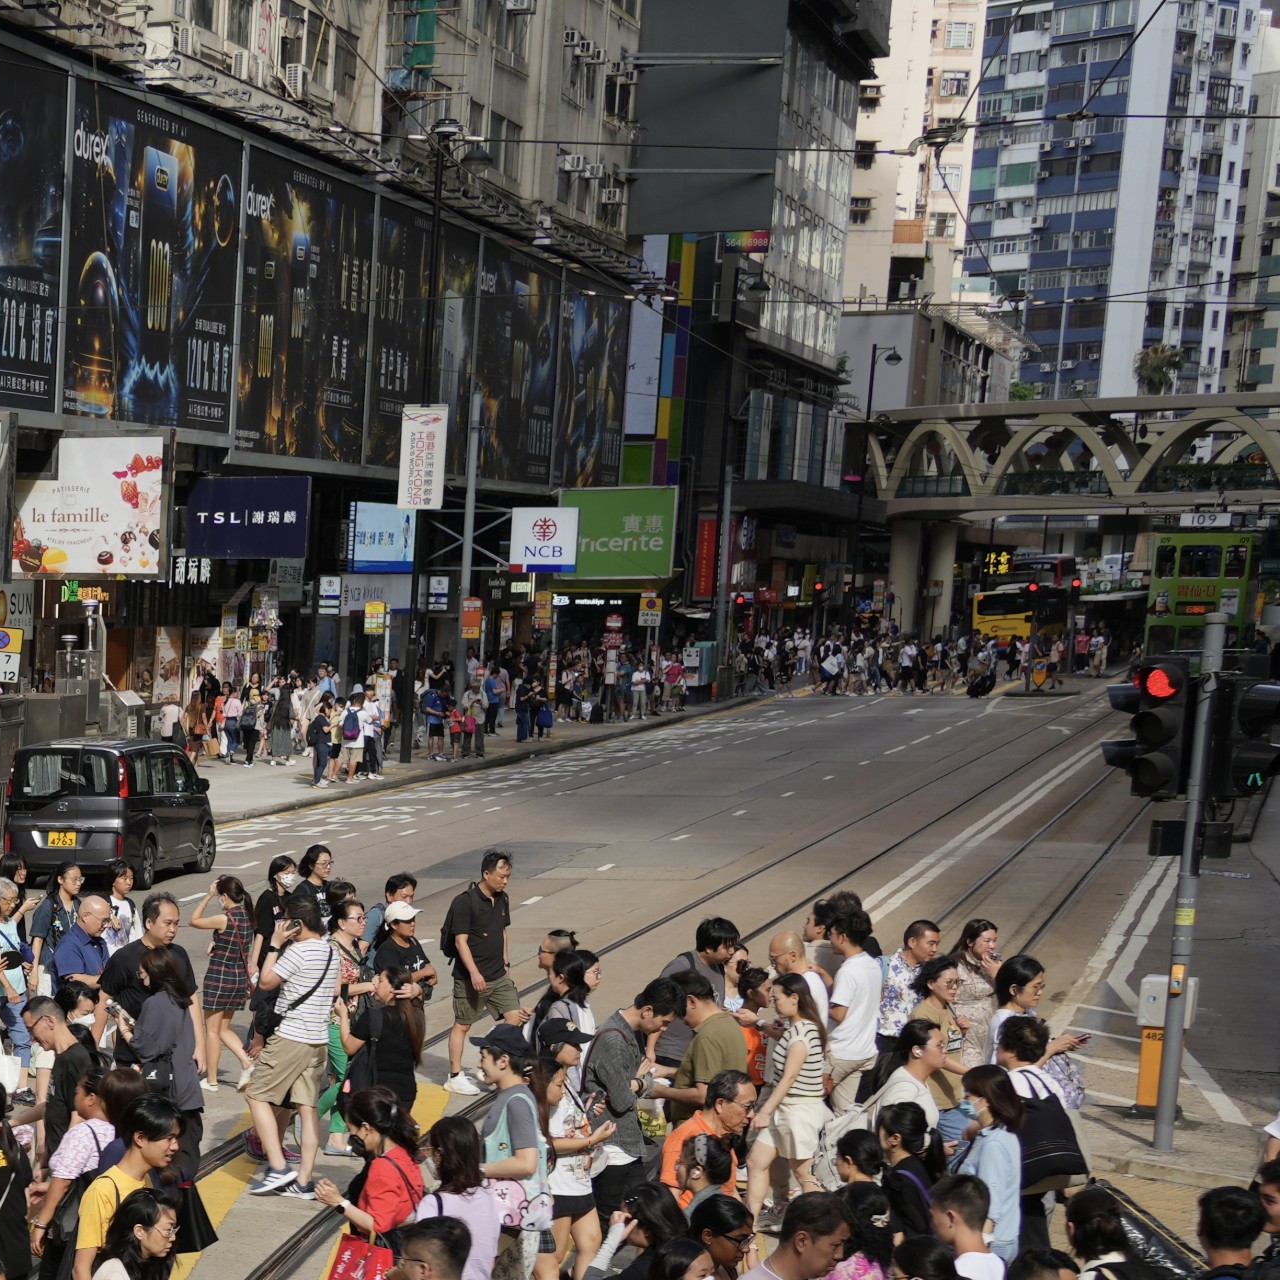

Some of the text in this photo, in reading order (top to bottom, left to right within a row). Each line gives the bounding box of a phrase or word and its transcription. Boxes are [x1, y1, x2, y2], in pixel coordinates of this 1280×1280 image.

[137, 109, 169, 133] GENERATED
[74, 122, 110, 166] durex
[246, 183, 273, 221] durex
[412, 431, 426, 506] HONG KONG
[406, 485, 414, 506] CITY
[31, 507, 110, 523] la famille
[197, 510, 297, 525] TSL 謝瑞麟
[1191, 514, 1217, 526] 109
[622, 514, 665, 534] 實惠
[523, 545, 563, 558] NCB
[579, 535, 663, 554] ricerite
[9, 592, 33, 616] SUN
[642, 617, 656, 625] 全日
[4, 654, 12, 665] 7
[3, 671, 16, 681] 12
[49, 838, 74, 846] 4763
